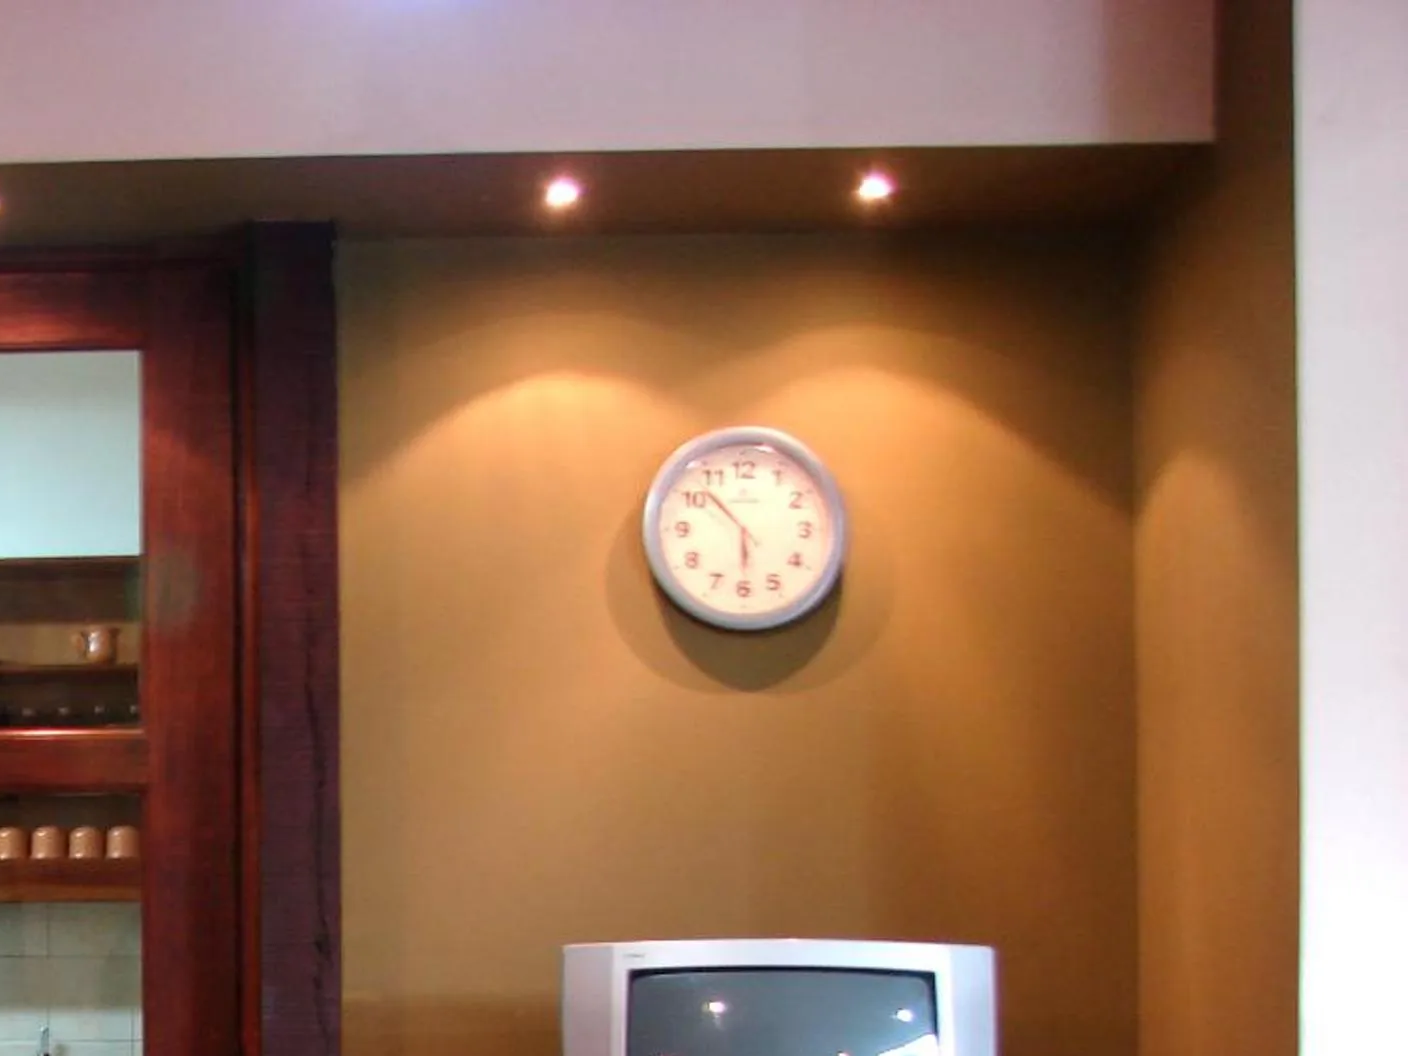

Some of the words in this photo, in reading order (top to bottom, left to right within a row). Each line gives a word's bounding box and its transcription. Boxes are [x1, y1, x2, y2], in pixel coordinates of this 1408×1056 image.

[703, 469, 724, 486] 11
[732, 460, 756, 479] 12
[773, 469, 783, 486] 1
[682, 491, 706, 509] 10
[789, 491, 804, 509] 2
[675, 521, 690, 538] 9
[797, 521, 812, 539] 3
[685, 551, 699, 569] 8
[787, 552, 804, 567] 4
[709, 572, 724, 589] 7
[736, 580, 751, 597] 6
[765, 573, 781, 590] 5
